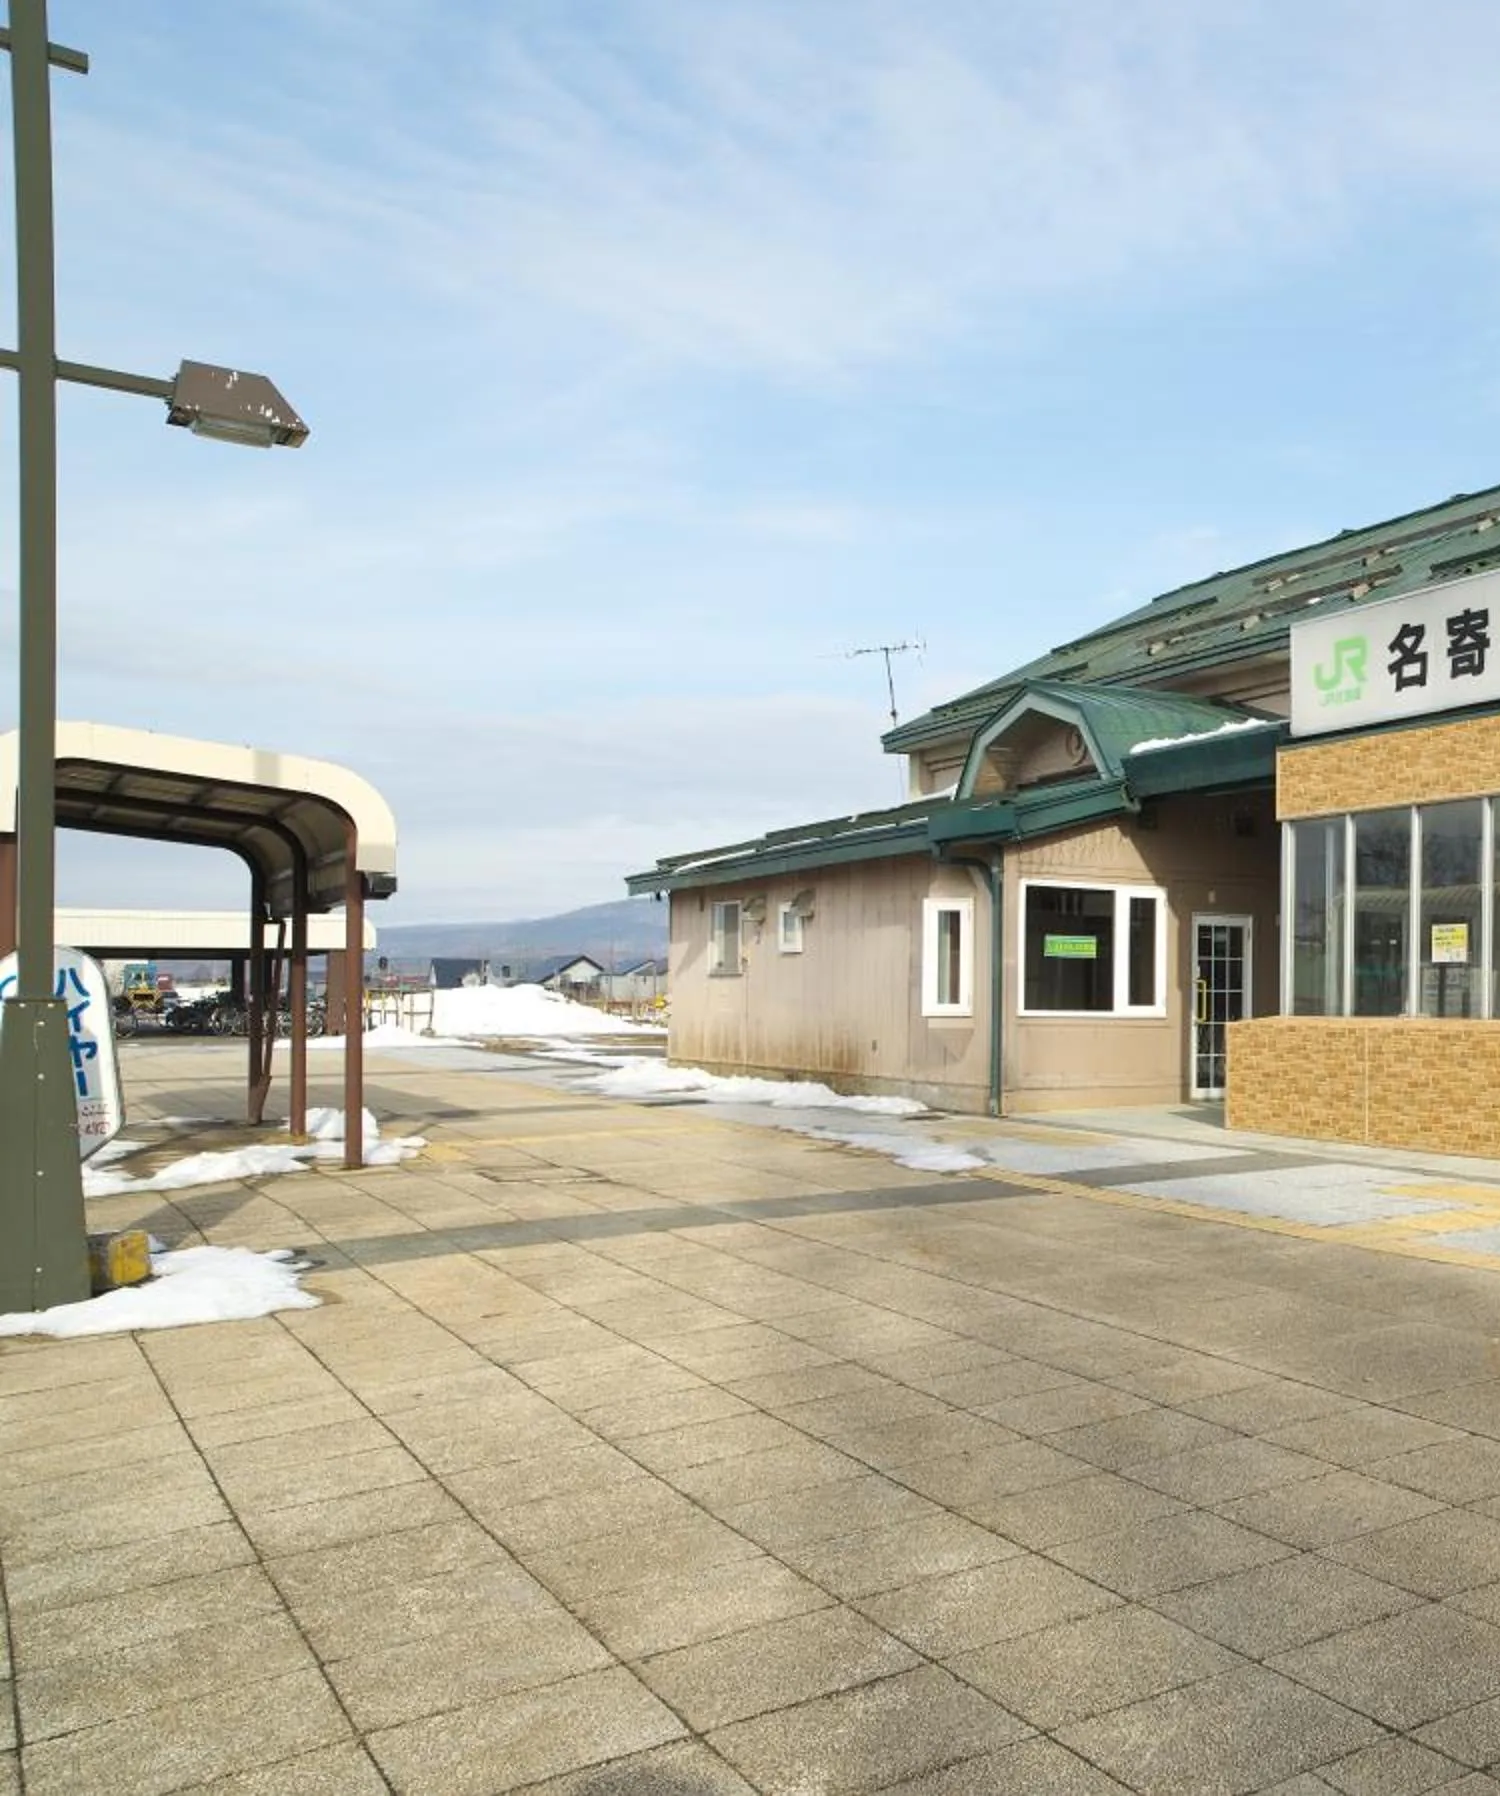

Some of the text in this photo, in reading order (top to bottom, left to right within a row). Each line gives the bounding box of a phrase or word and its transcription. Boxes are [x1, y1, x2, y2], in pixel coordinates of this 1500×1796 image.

[1314, 635, 1369, 691] JR
[55, 966, 99, 1098] ハイヤー
